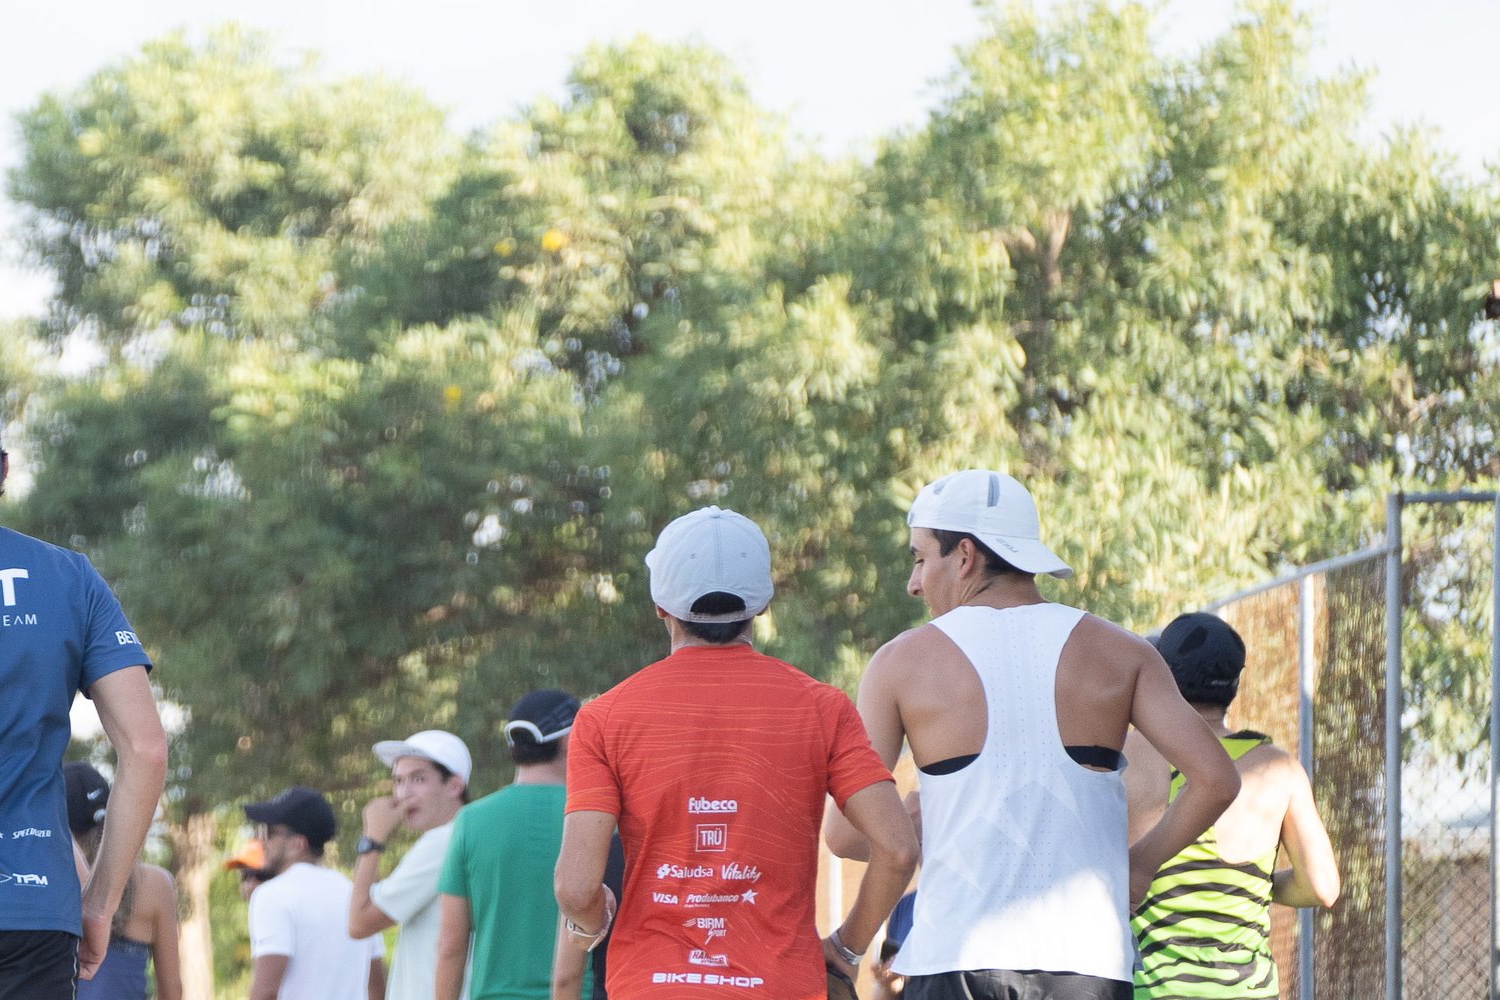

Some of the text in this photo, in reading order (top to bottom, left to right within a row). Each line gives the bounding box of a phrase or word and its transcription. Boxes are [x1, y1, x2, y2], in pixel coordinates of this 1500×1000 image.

[670, 862, 762, 883] Saludsa Vitality
[652, 892, 739, 904] VISA Produbanco
[697, 918, 724, 928] BIRM
